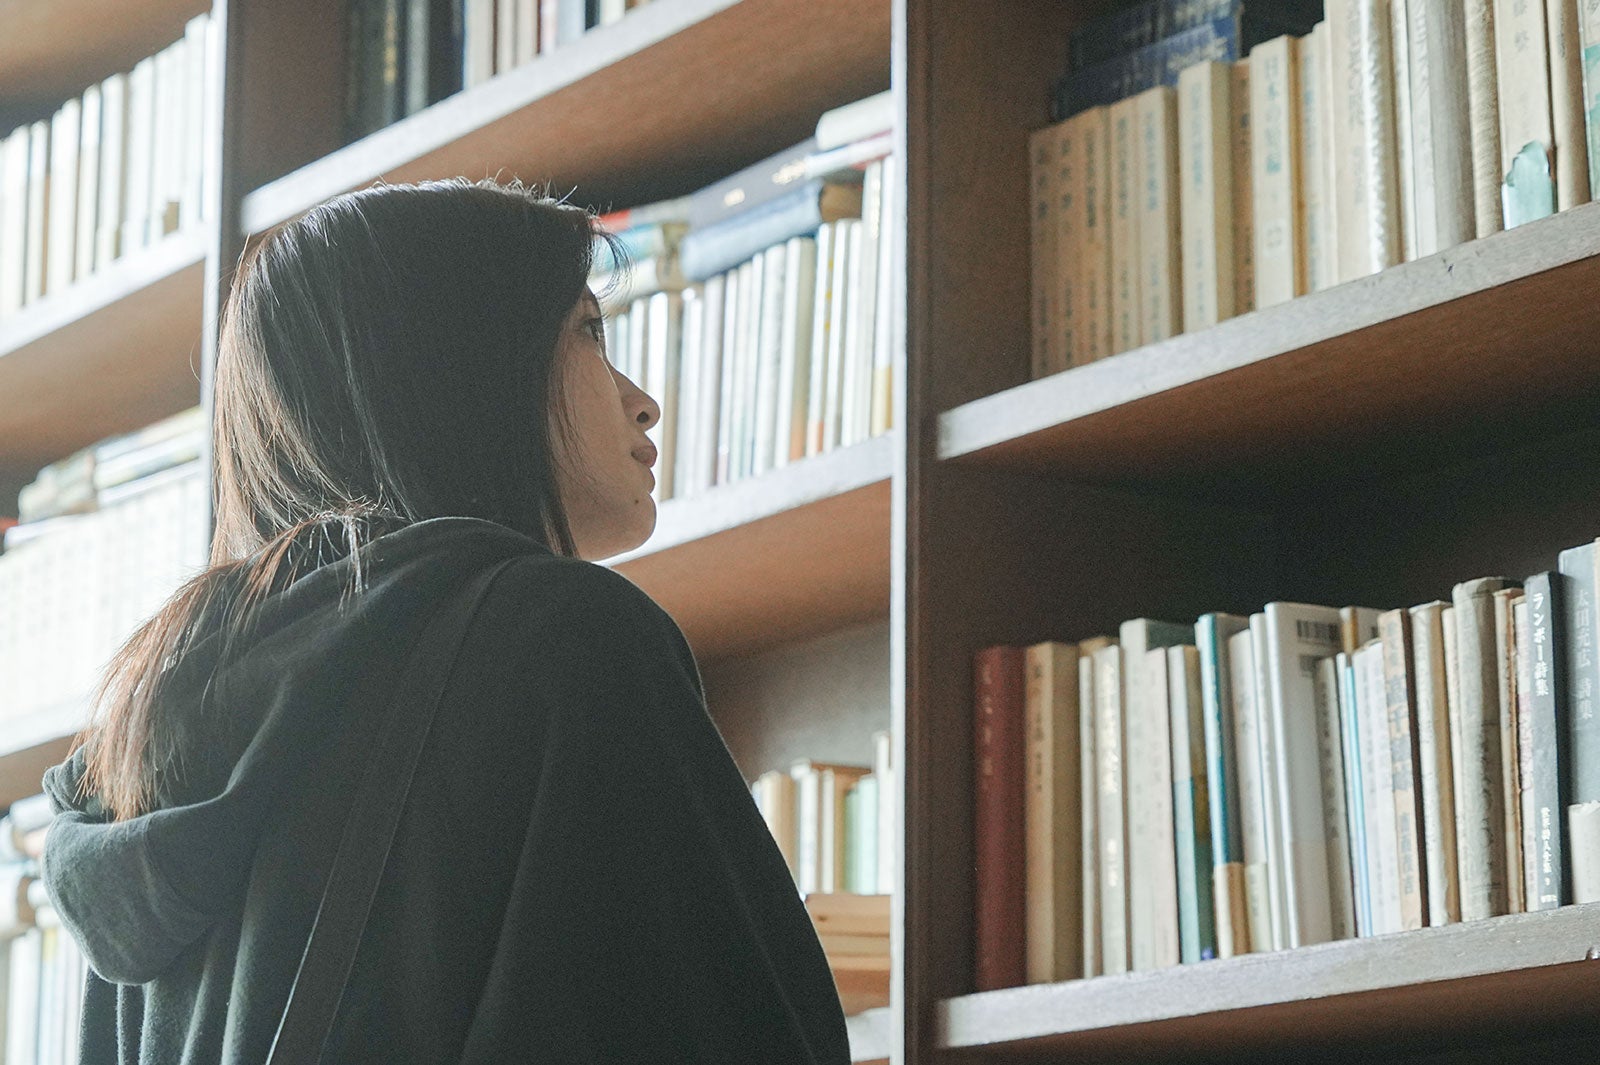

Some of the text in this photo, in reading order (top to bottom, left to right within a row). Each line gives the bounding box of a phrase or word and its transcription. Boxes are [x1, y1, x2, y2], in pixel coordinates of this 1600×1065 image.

[1532, 592, 1549, 696] ランボー詩集
